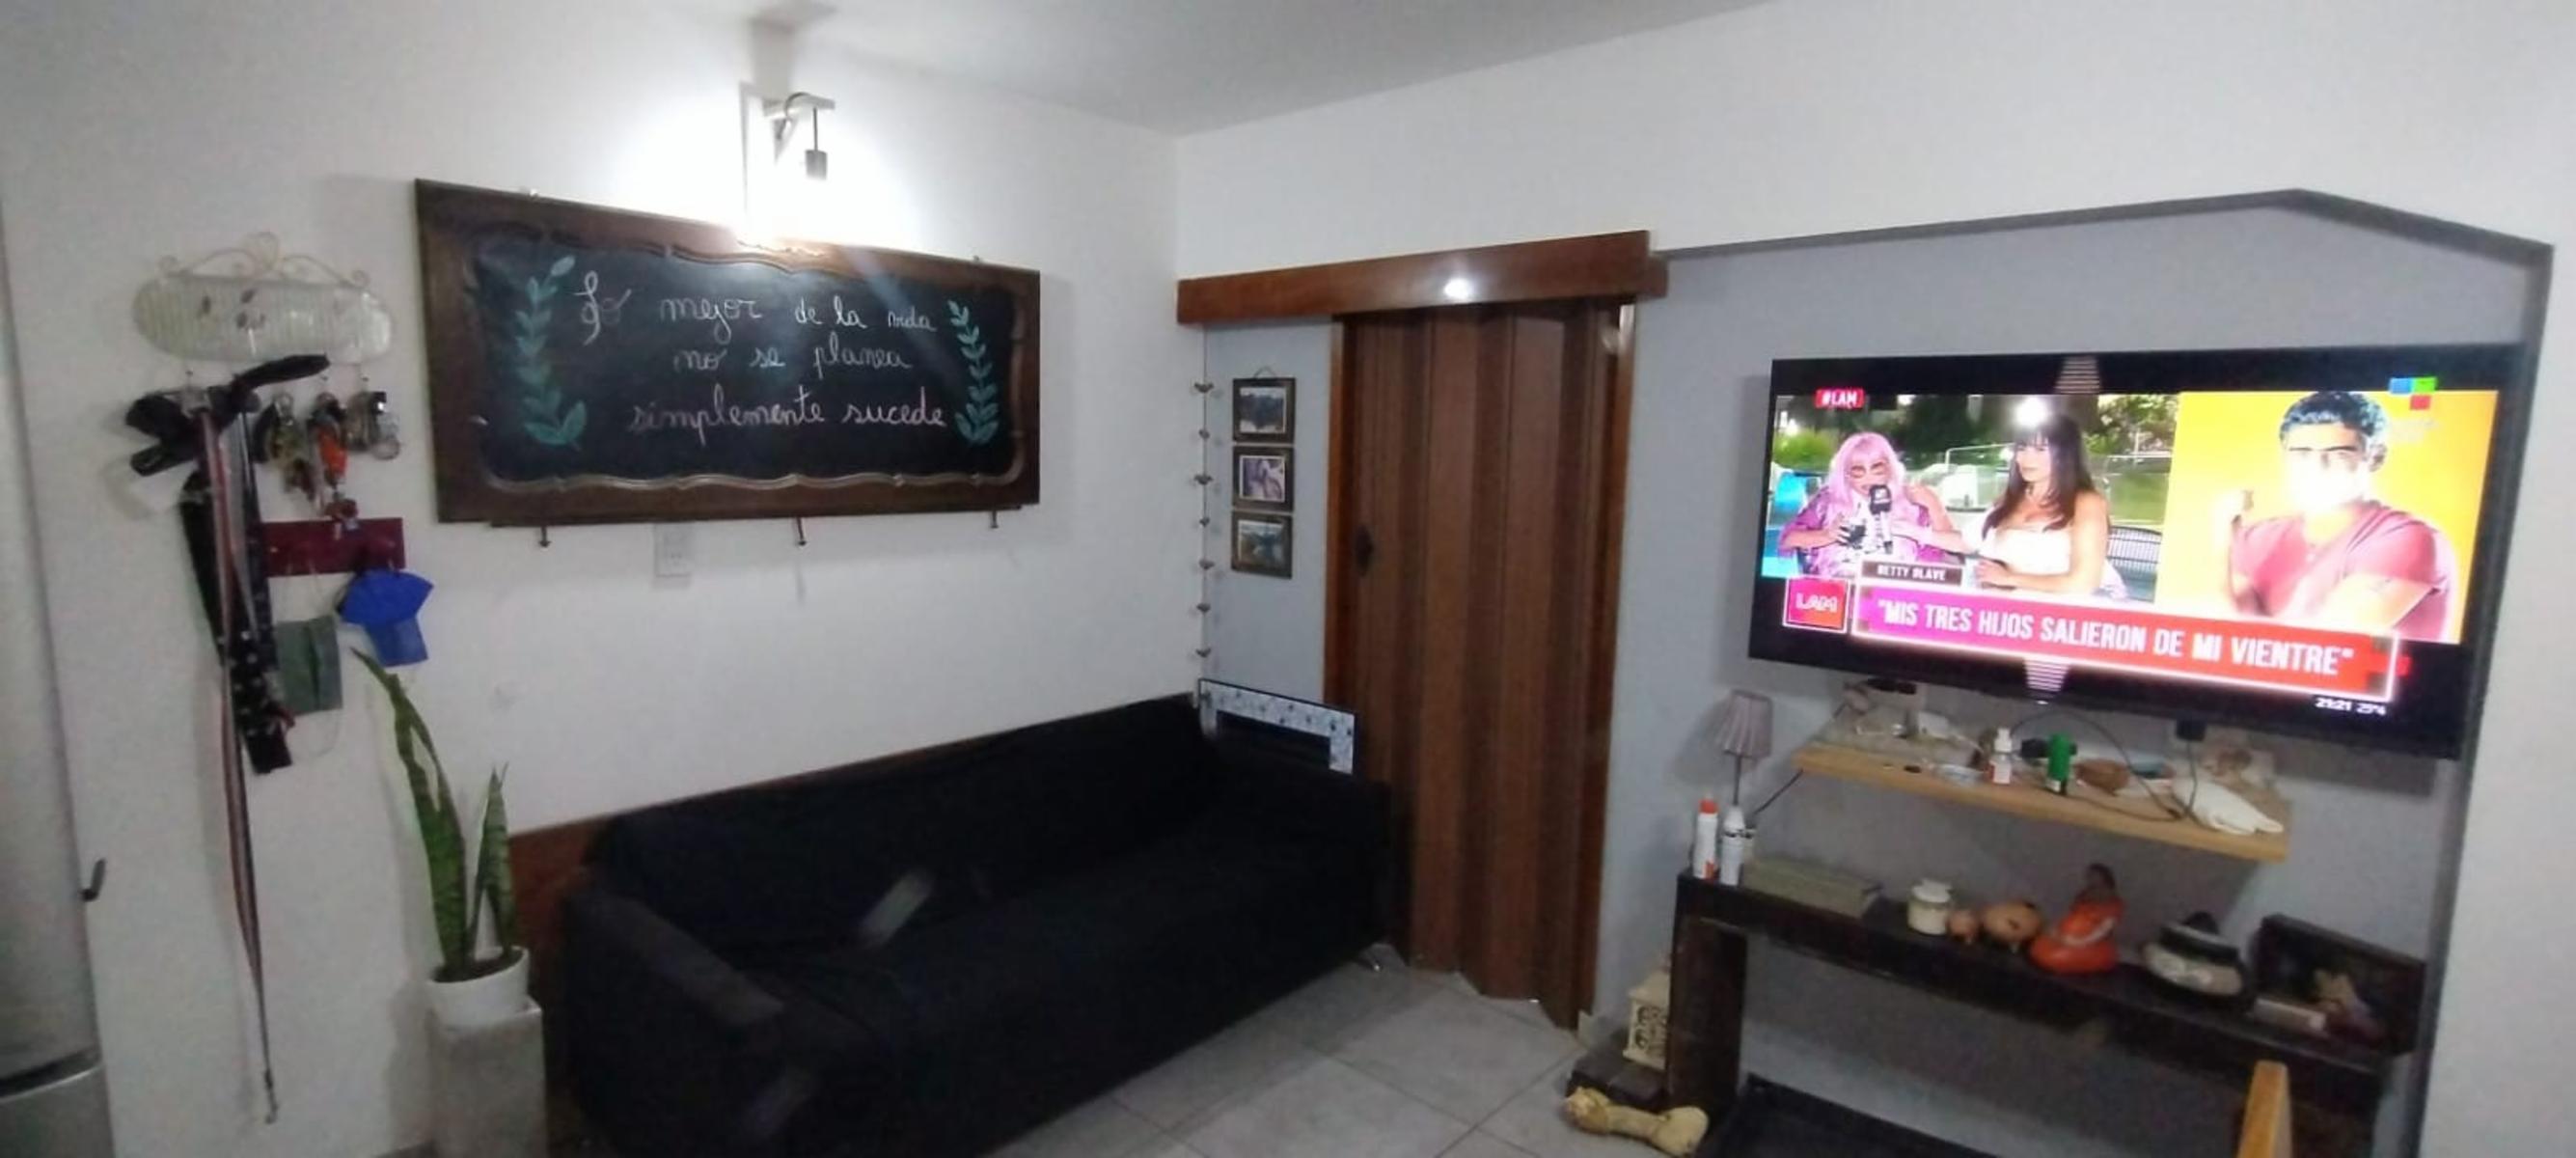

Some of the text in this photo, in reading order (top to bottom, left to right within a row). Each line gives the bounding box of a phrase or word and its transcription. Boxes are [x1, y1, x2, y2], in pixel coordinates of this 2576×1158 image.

[574, 271, 937, 345] Lo mejor de la vida
[673, 330, 913, 381] no se planea
[629, 383, 946, 446] simplemente sucede
[1821, 389, 1858, 406] #LAM
[1877, 565, 1909, 577] BETTY
[1795, 593, 1838, 613] LAM
[1878, 599, 2355, 675] "MIS TRES HIJOS SALIERON DE MI VIENTRE"
